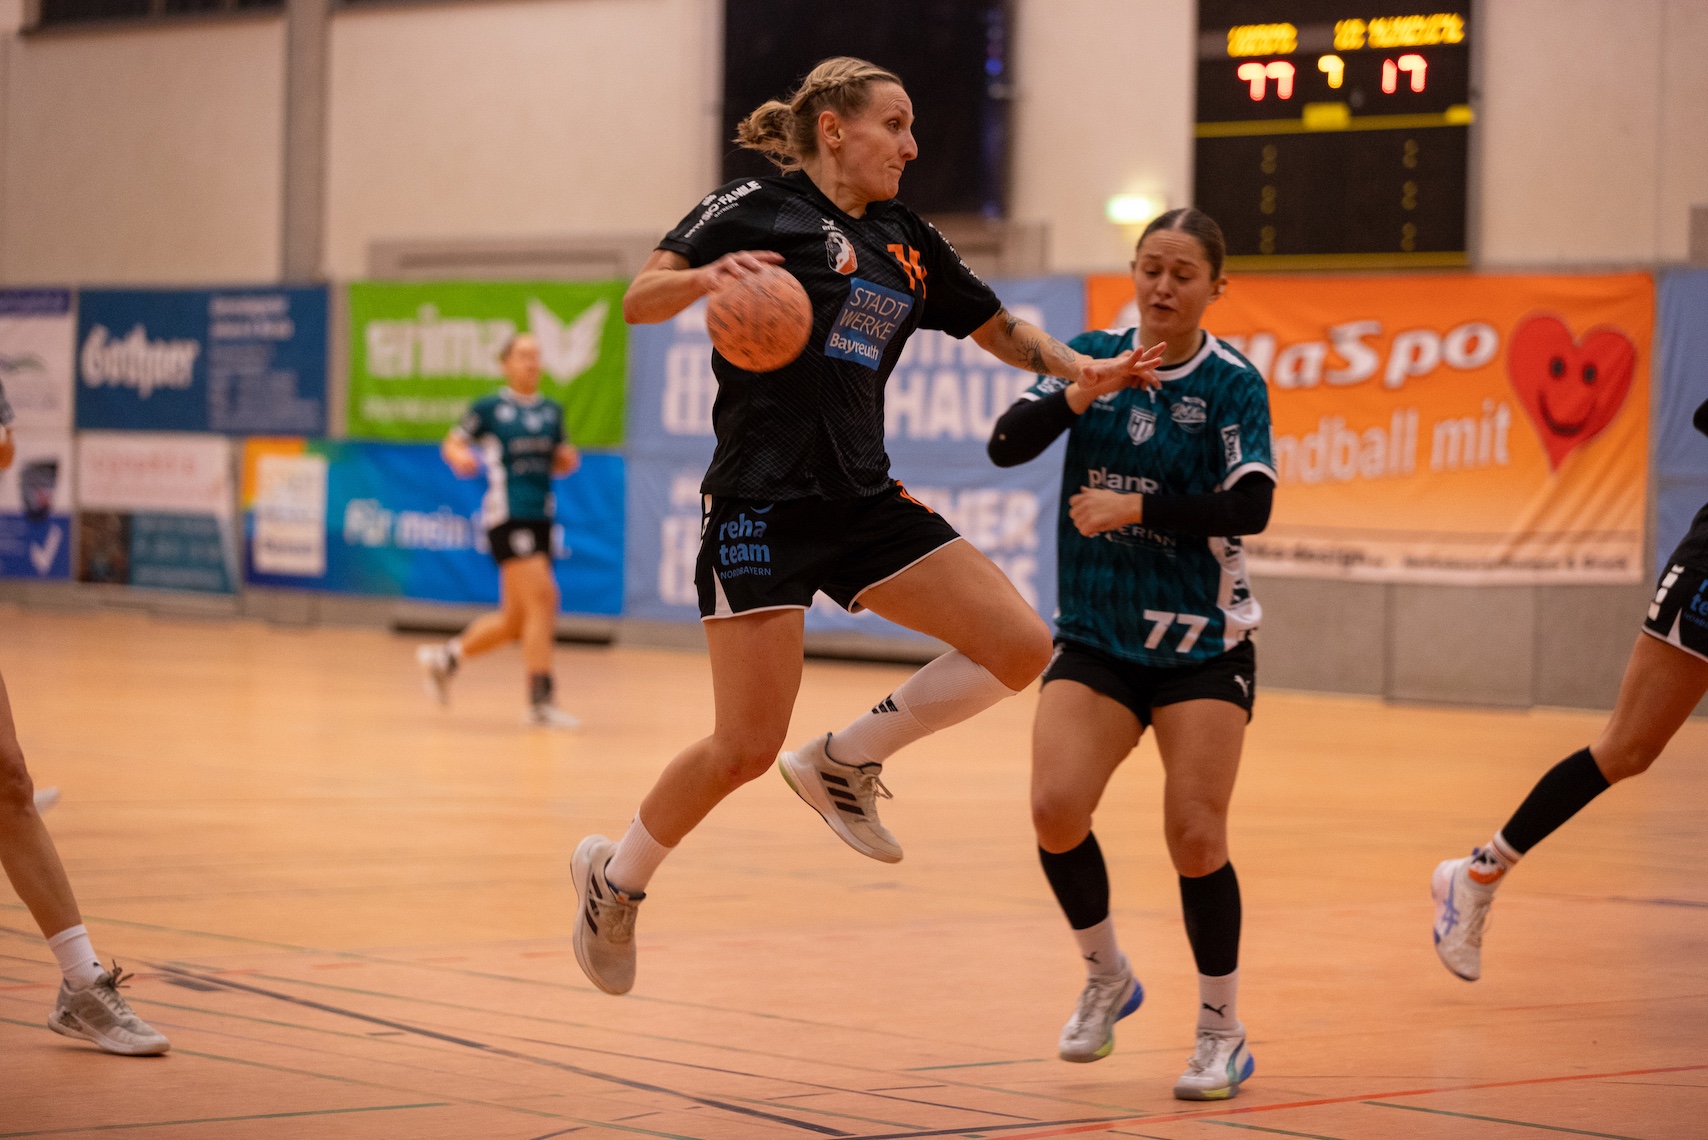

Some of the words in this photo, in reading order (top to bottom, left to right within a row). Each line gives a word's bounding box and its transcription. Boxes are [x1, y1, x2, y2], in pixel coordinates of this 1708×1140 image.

[849, 287, 909, 320] STADT
[839, 308, 896, 340] WERKE
[829, 332, 880, 361] Bayreuth
[1431, 397, 1512, 473] mit
[719, 513, 768, 541] reha
[719, 543, 771, 566] team
[1143, 609, 1211, 654] 77
